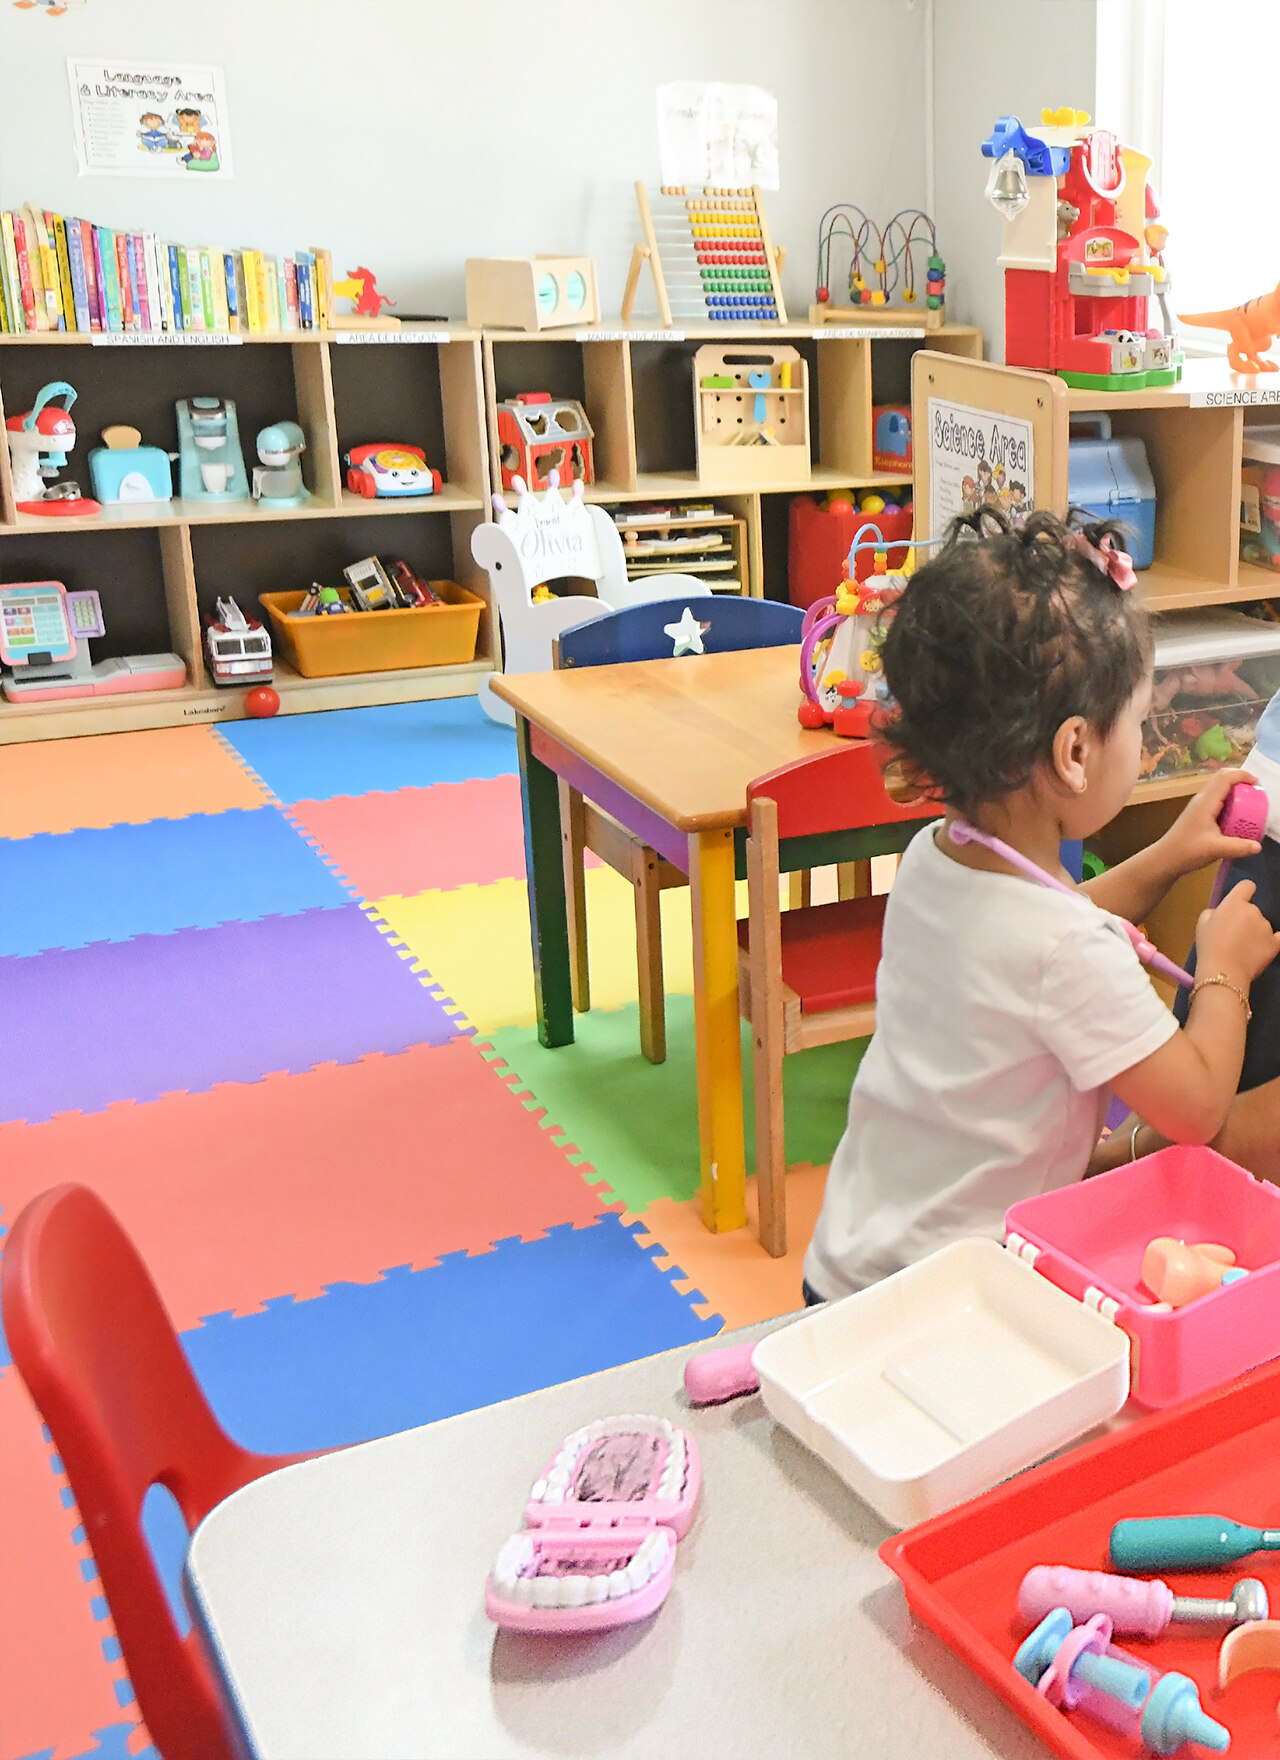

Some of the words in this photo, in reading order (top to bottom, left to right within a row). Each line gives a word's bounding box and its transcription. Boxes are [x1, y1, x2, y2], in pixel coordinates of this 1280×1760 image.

[103, 69, 182, 88] Language
[95, 85, 169, 103] Literacy
[174, 89, 215, 103] Area
[106, 335, 155, 344] SPANISH
[157, 335, 180, 343] AND
[181, 335, 230, 343] ENGLISH
[1206, 391, 1257, 405] SCIENCE
[934, 410, 985, 461] Science
[989, 425, 1026, 472] Area
[521, 530, 583, 559] Olivia
